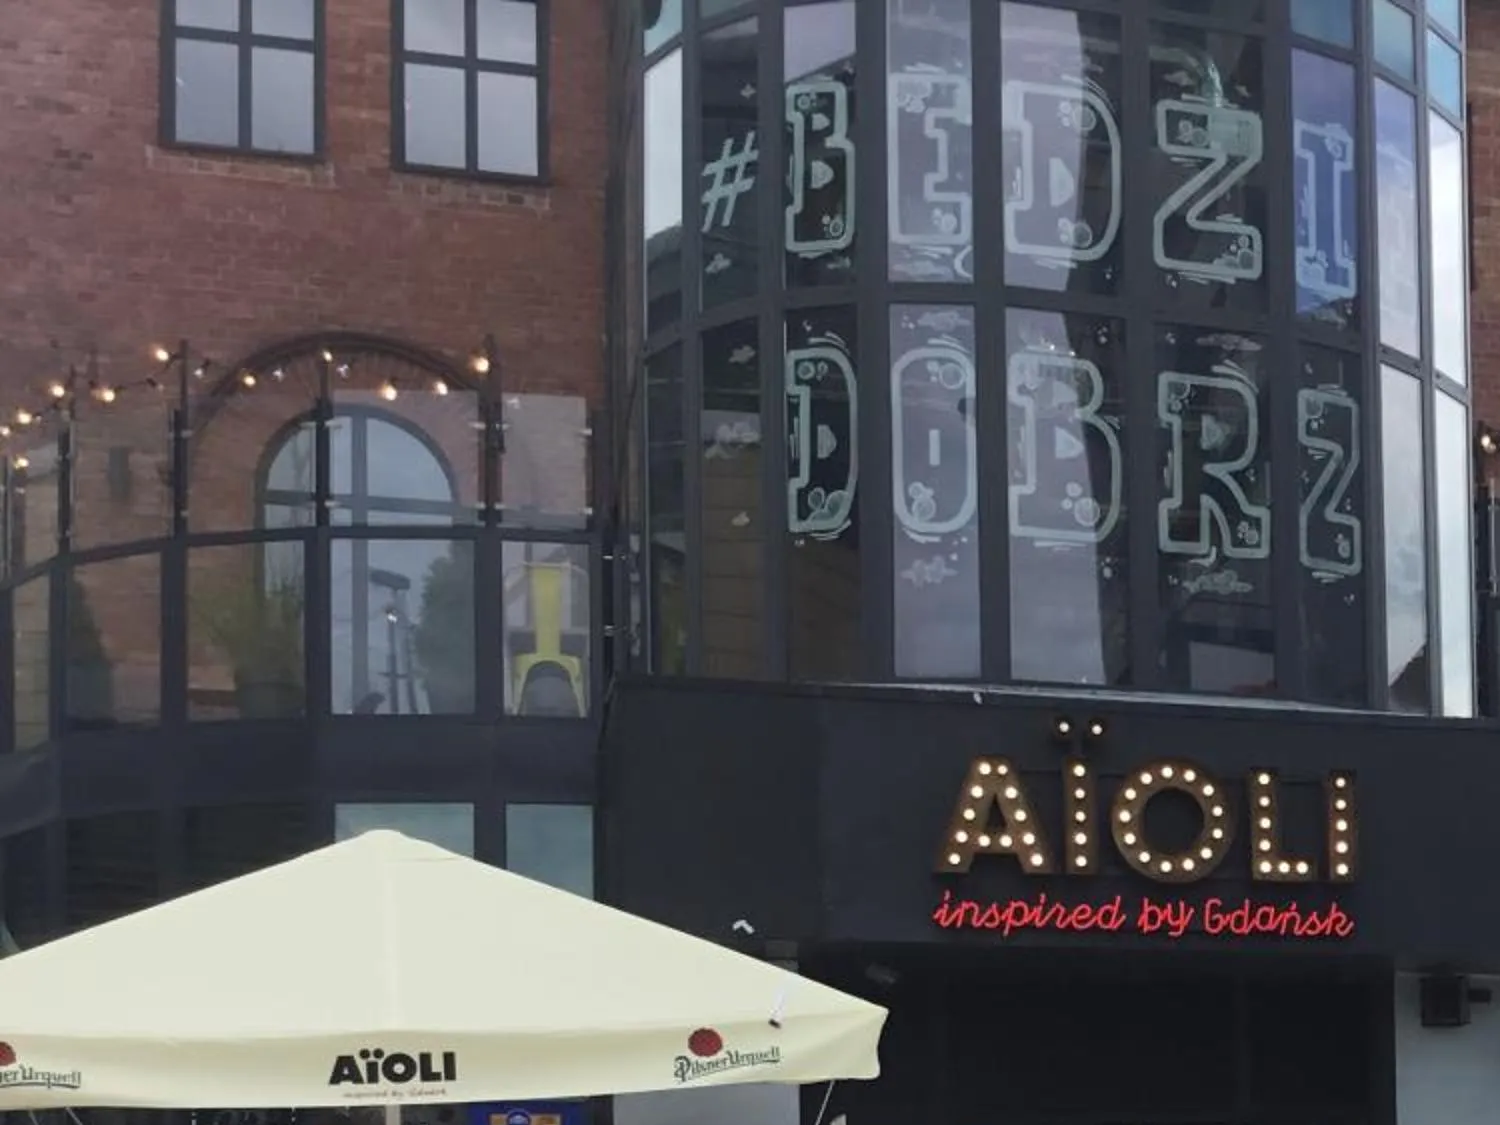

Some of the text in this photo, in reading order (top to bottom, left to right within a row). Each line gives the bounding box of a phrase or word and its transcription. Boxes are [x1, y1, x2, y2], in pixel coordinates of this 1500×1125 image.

[933, 890, 1355, 937] inspired by Gdańsk
